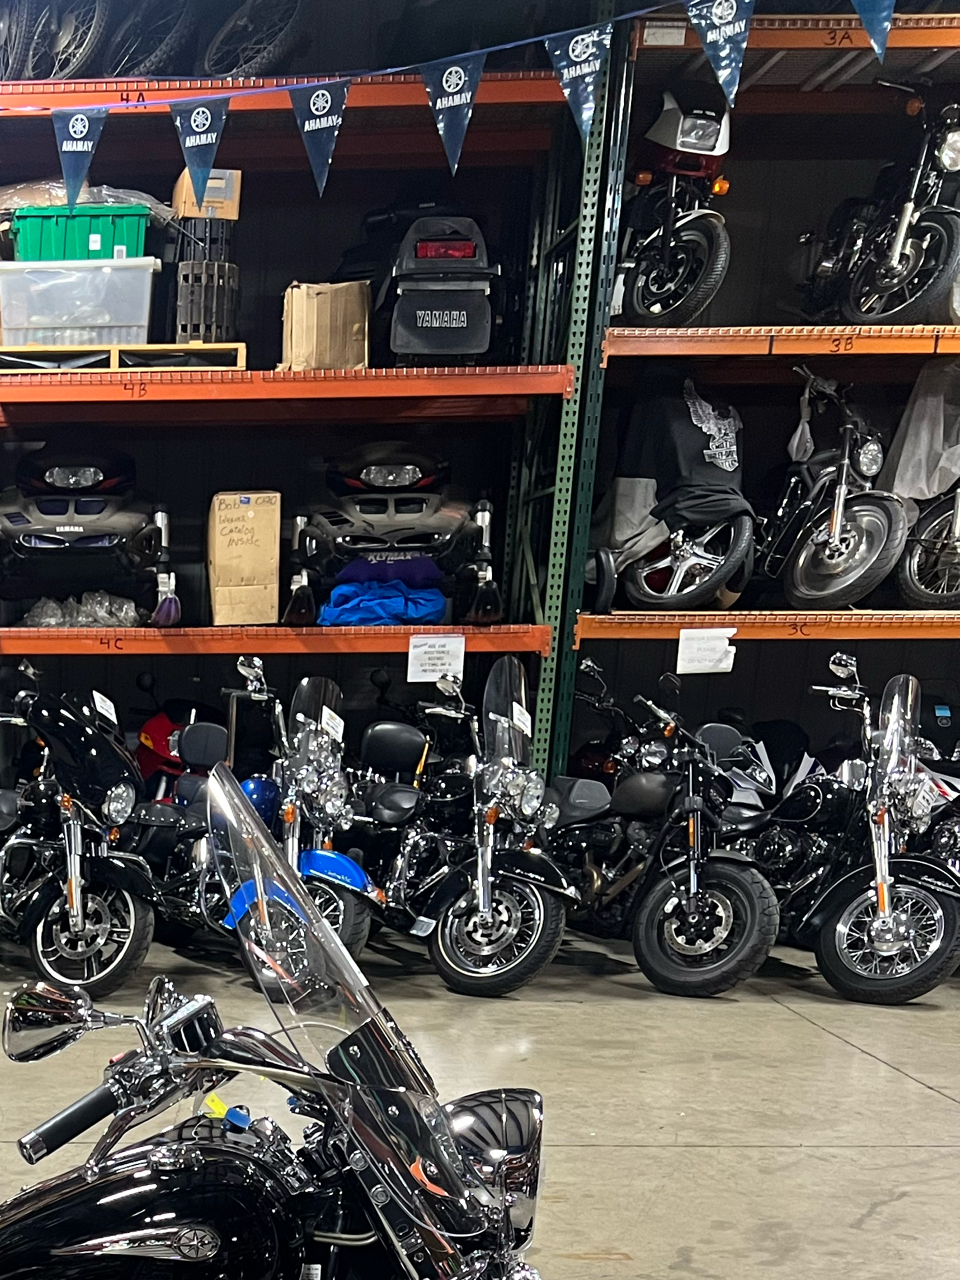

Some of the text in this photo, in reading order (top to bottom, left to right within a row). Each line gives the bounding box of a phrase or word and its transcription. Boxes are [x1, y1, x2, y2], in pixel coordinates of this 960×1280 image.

[824, 30, 853, 46] 3A
[120, 92, 147, 109] 4A
[416, 310, 468, 328] YAMAHA
[829, 336, 854, 352] 3B
[123, 382, 148, 398] 4B
[218, 498, 240, 511] Bob
[787, 623, 811, 636] 3C
[100, 638, 123, 650] 4C
